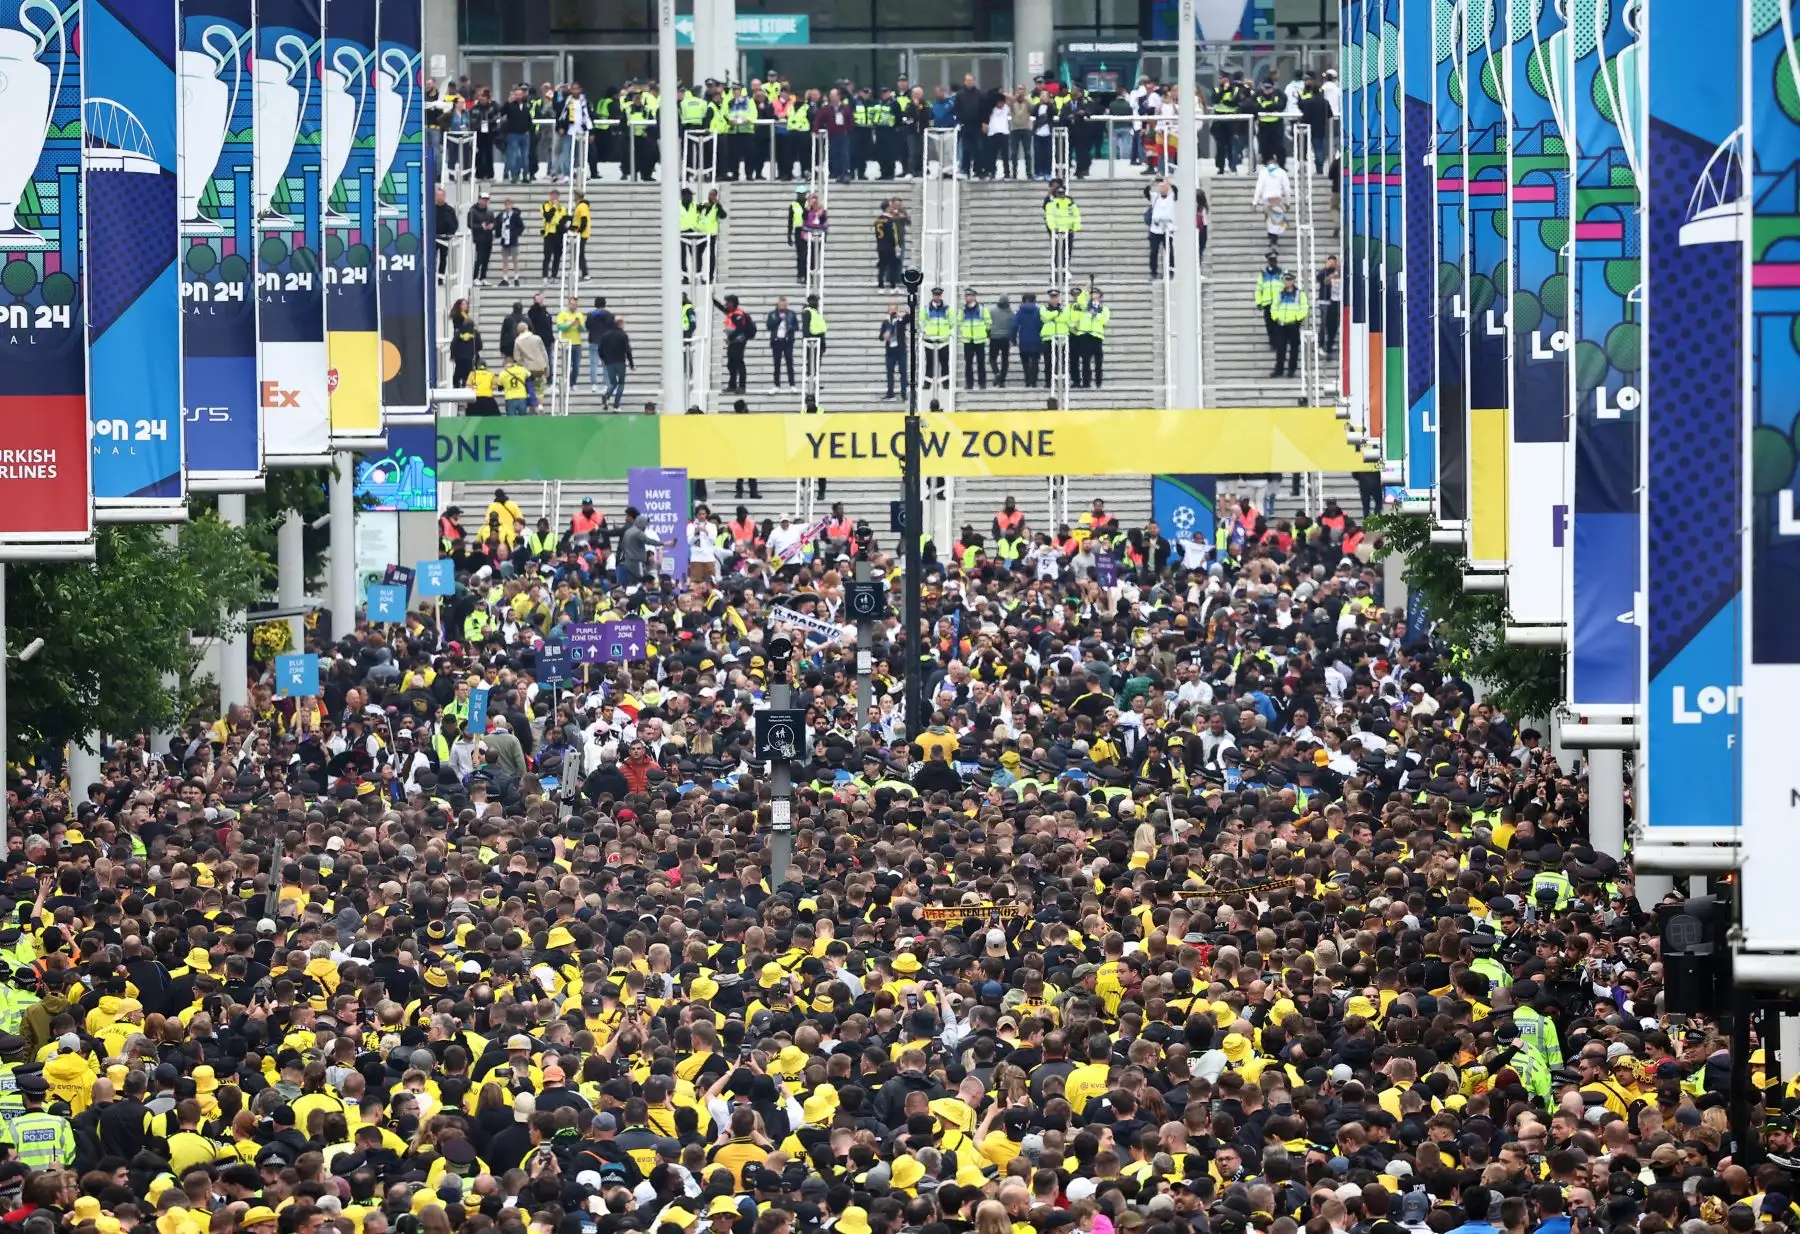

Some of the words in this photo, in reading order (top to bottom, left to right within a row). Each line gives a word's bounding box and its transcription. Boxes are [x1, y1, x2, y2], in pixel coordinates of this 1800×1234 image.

[391, 254, 415, 271] 24
[285, 272, 312, 291] 24
[342, 267, 367, 284] 24
[214, 282, 243, 302] 24
[34, 304, 70, 329] 24
[262, 380, 301, 408] Ex
[92, 419, 129, 441] on
[134, 419, 167, 441] 24
[437, 435, 502, 463] ONE
[806, 431, 950, 460] YELLOW
[961, 429, 1056, 458] ZONE
[645, 489, 671, 499] HAVE
[645, 501, 671, 511] YOUR
[641, 512, 678, 522] CKETS
[648, 524, 675, 534] EADY
[615, 624, 636, 632] PURPLE
[24, 1132, 54, 1142] POLICE
